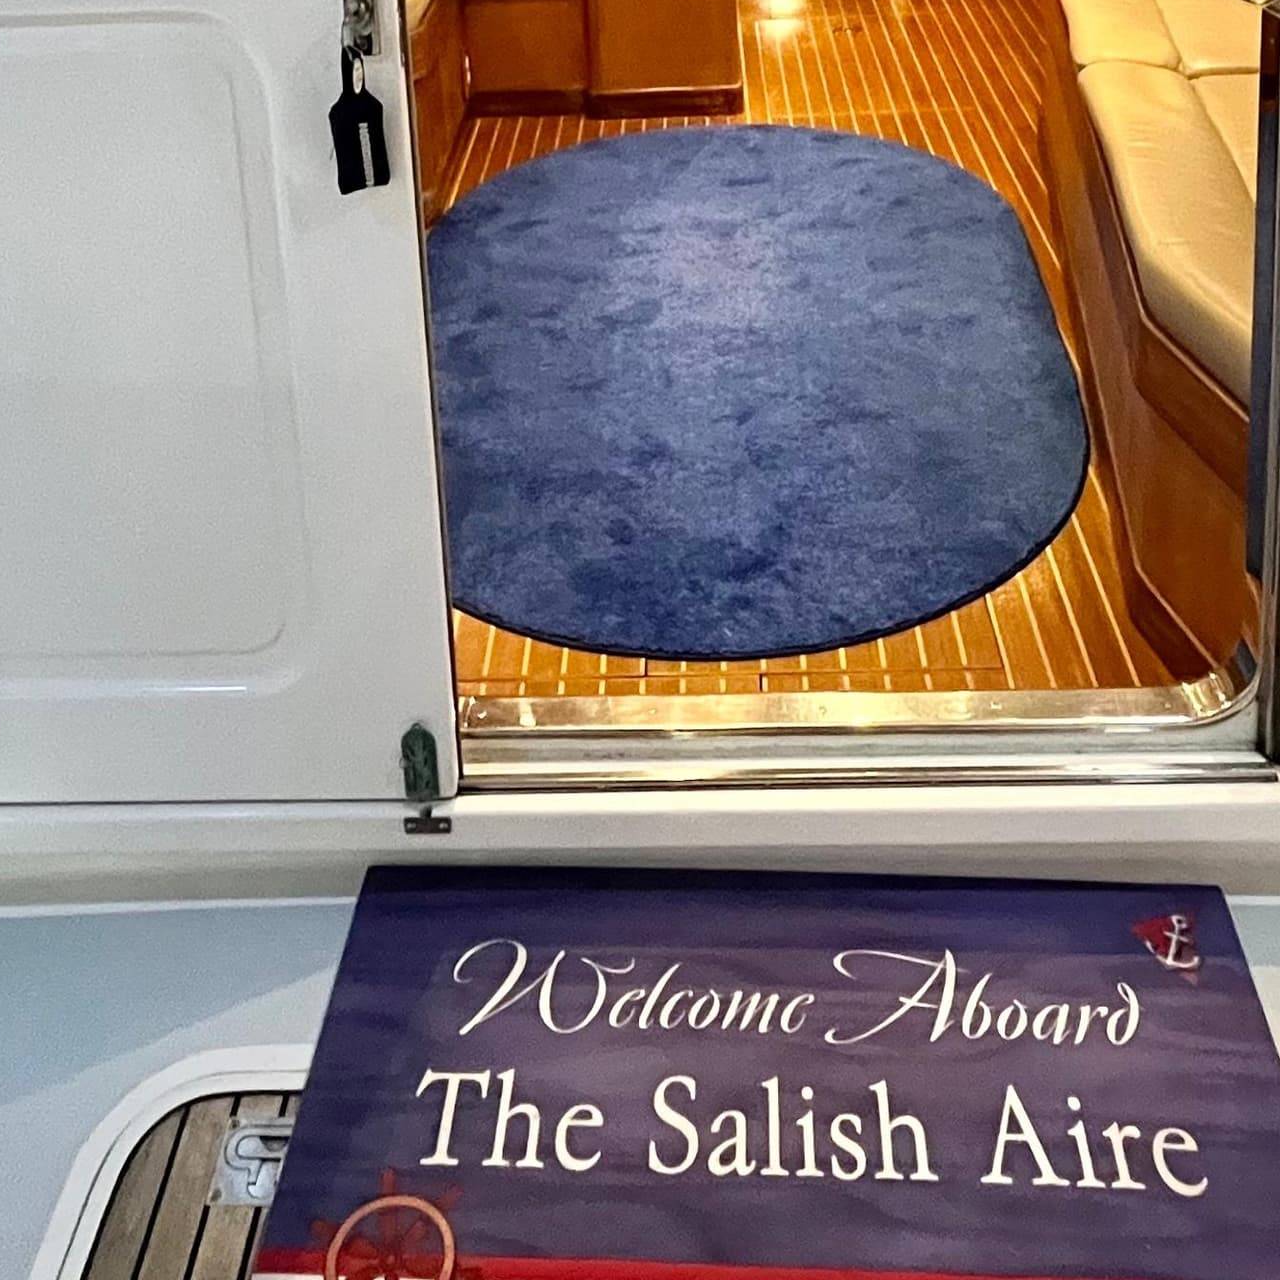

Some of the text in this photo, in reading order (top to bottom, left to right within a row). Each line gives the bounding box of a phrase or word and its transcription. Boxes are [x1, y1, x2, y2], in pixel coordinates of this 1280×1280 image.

[452, 937, 1141, 1046] Welcome Aboard
[415, 1067, 1209, 1197] The Salish Aire
